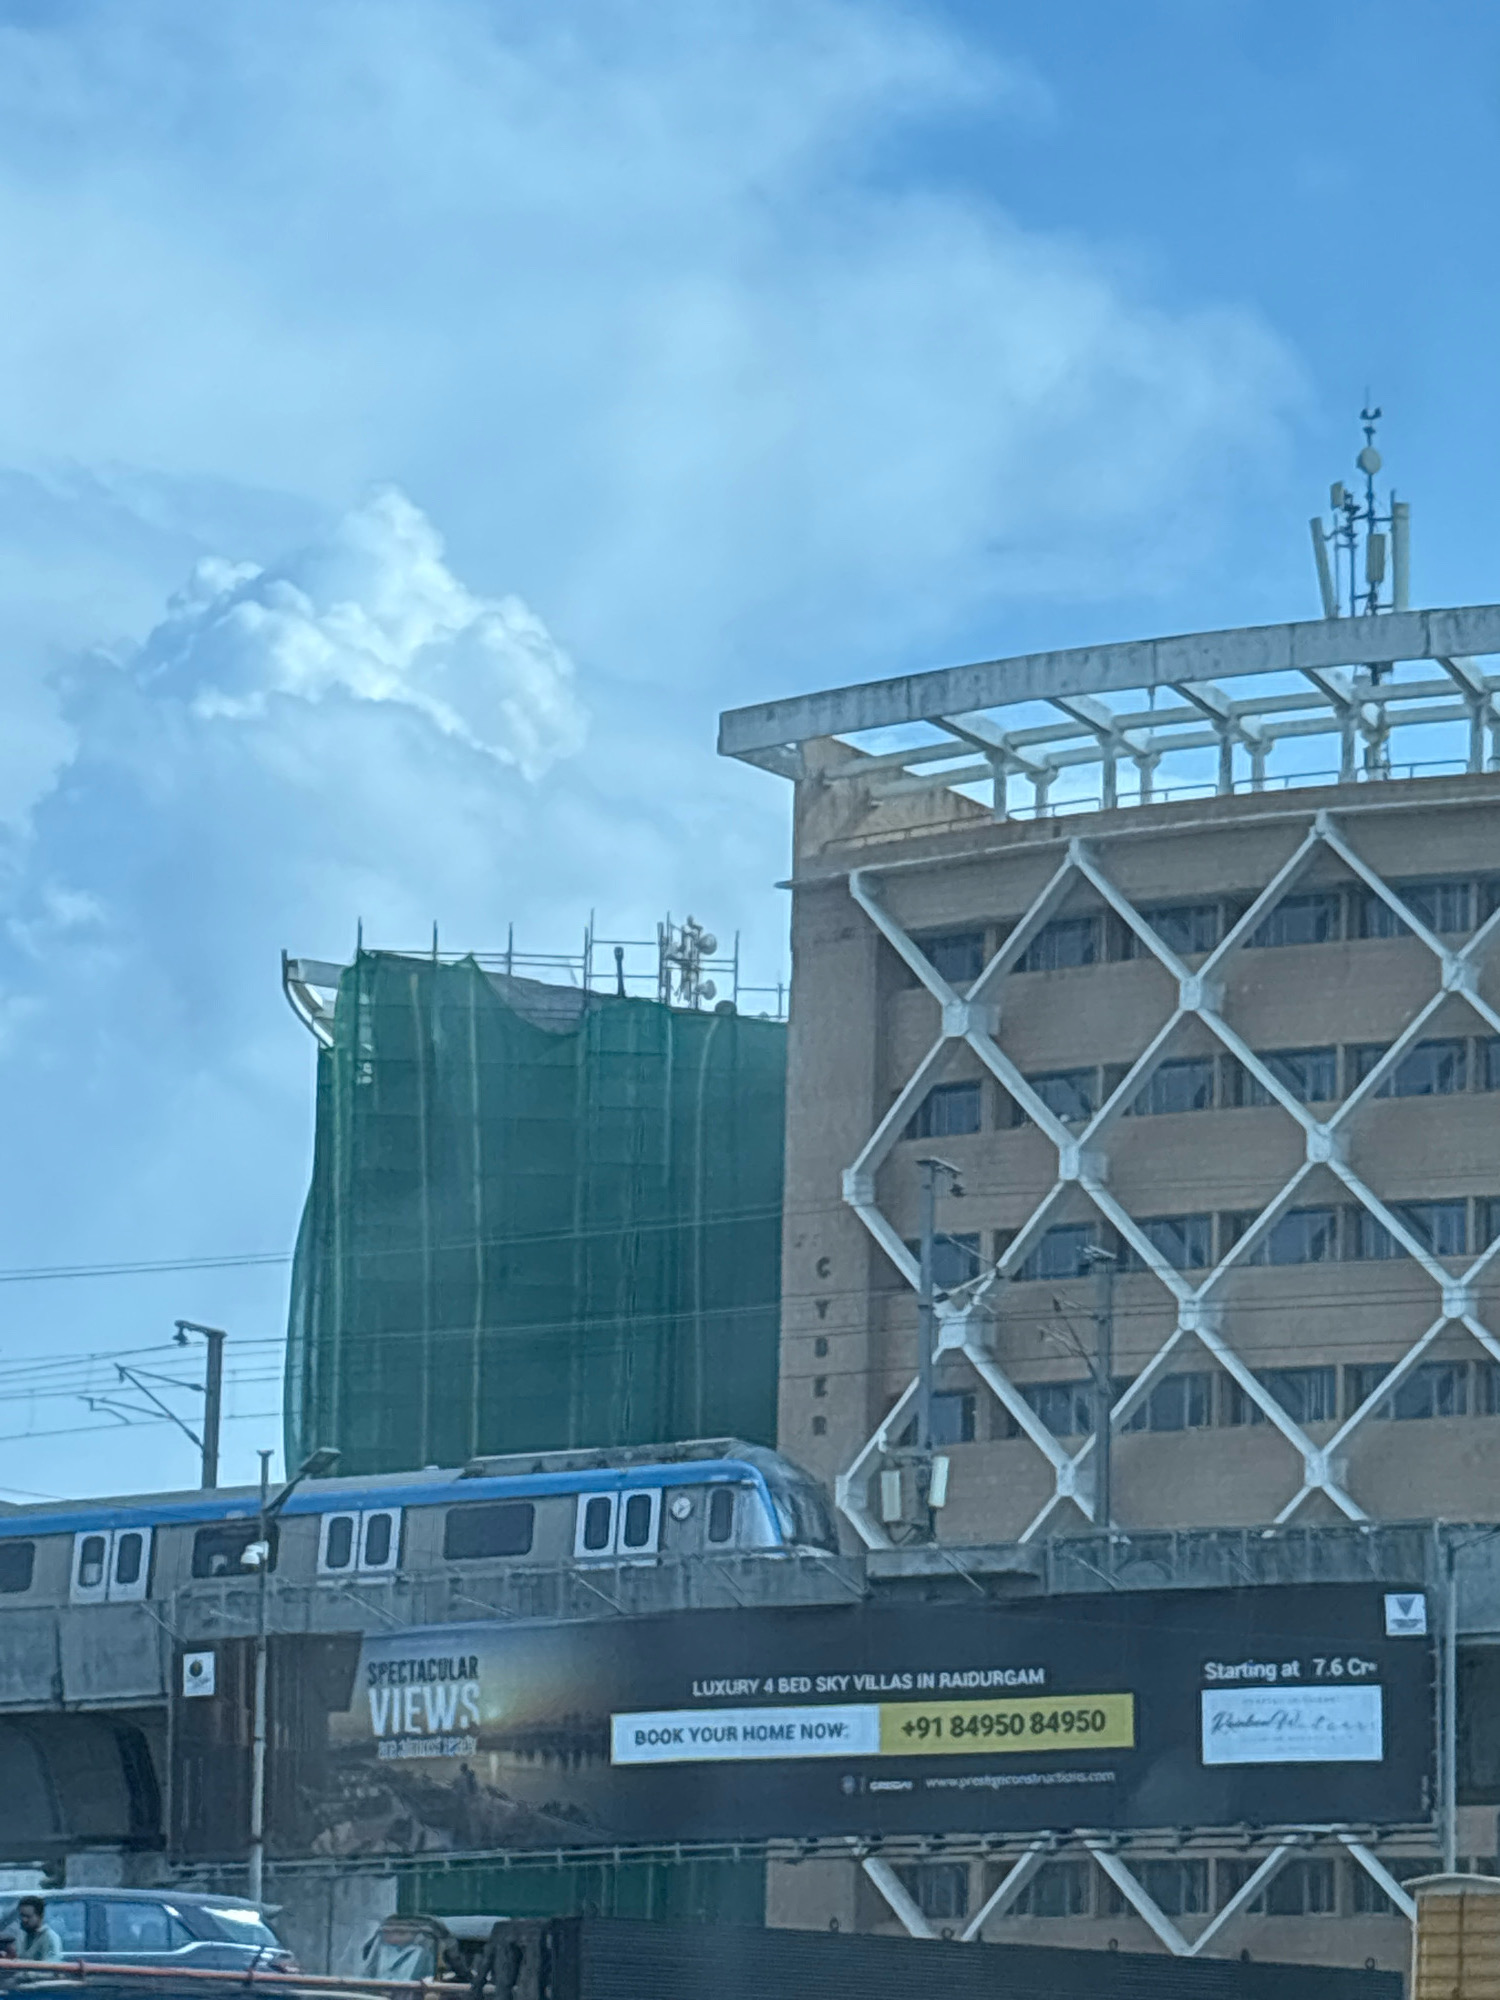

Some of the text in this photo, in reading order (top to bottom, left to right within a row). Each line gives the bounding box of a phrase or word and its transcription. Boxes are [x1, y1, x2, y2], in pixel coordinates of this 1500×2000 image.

[368, 1655, 479, 1685] SPECTACULAR
[692, 1668, 1046, 1697] LUXURY 4 BED SKY VILLAS IN RAIDURGAM
[1204, 1660, 1277, 1682] Starting
[1281, 1660, 1300, 1677] at
[1313, 1658, 1344, 1676] 7.6
[368, 1682, 480, 1736] VIEWS
[635, 1728, 684, 1746] BOOK
[688, 1725, 738, 1743] YOUR
[743, 1723, 796, 1742] HOME
[901, 1709, 1106, 1739] +91 84950 84950
